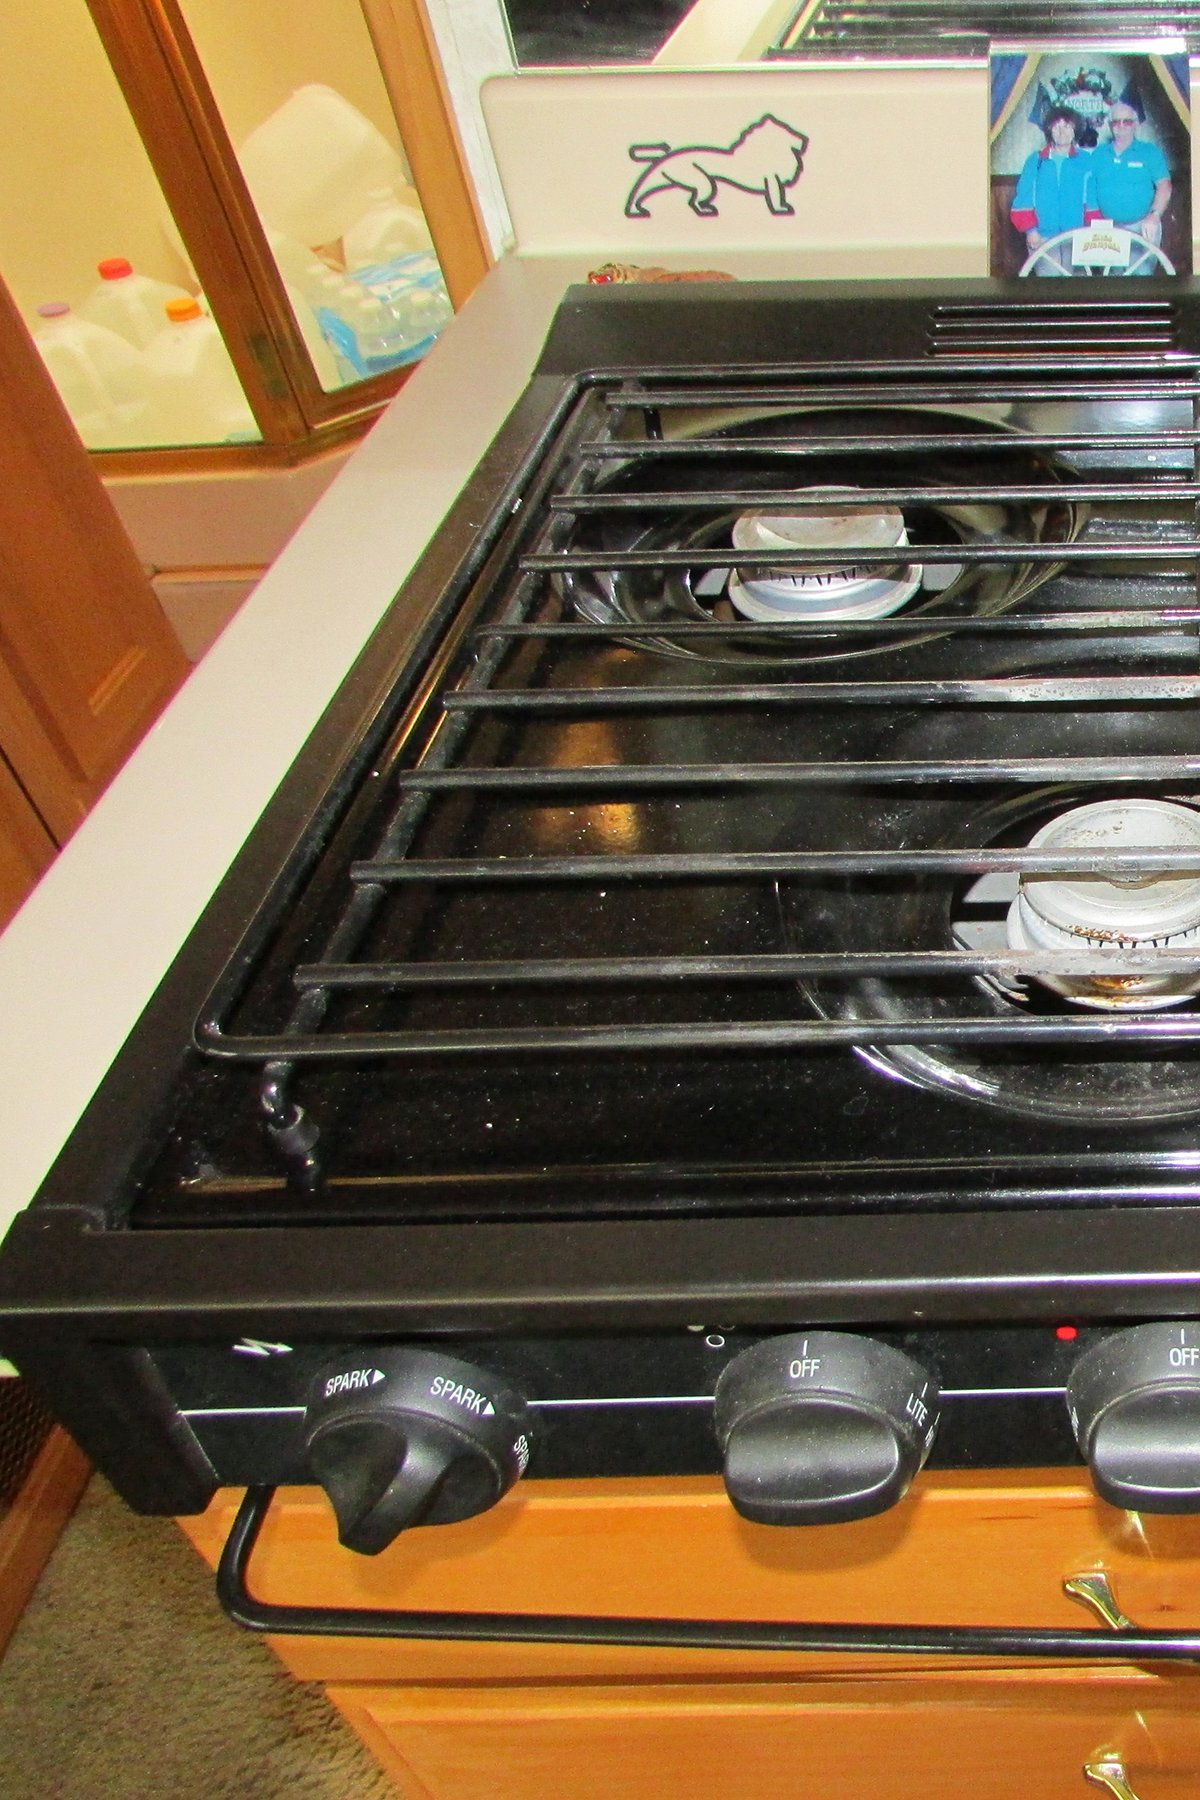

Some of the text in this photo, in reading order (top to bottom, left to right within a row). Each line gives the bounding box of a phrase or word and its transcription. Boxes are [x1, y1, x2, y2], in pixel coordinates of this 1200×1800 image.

[789, 1358, 821, 1379] OFF
[1169, 1347, 1200, 1367] OFF
[325, 1368, 373, 1398] SPARK
[430, 1375, 487, 1415] SPARK
[905, 1392, 929, 1428] LITE
